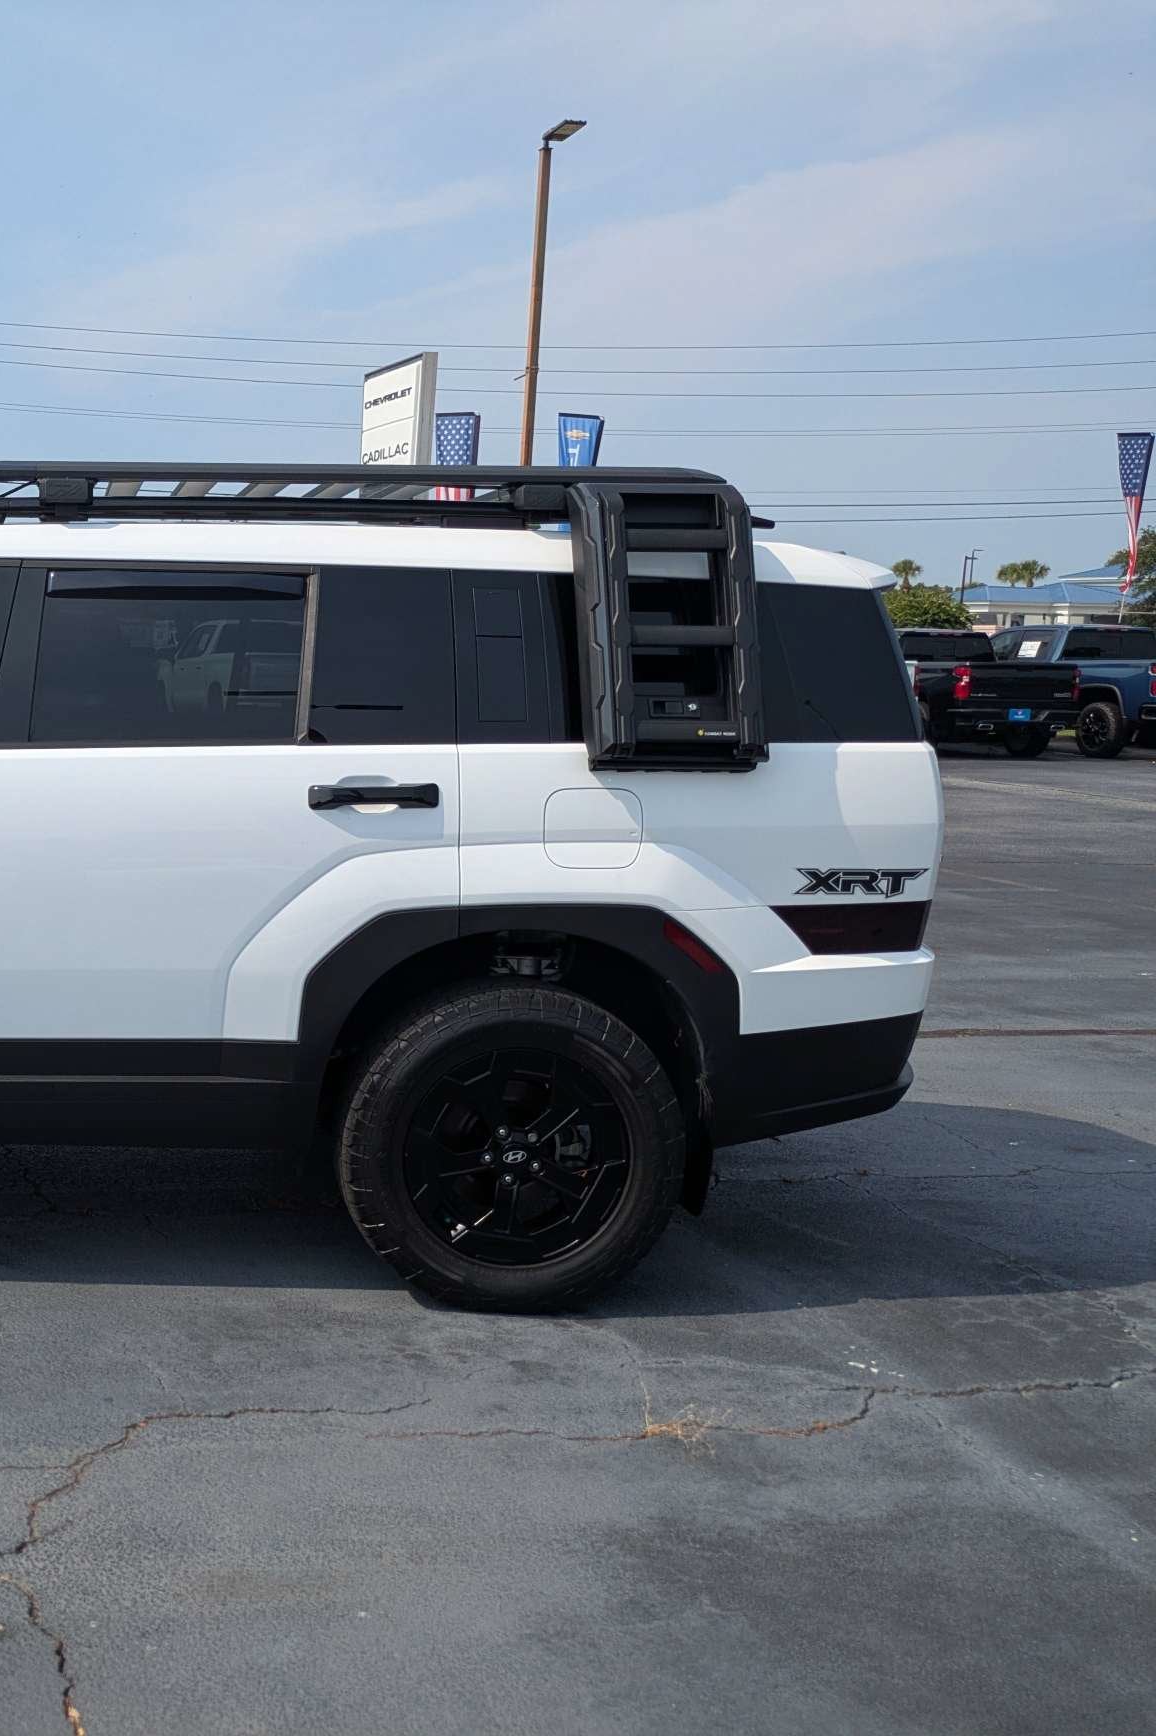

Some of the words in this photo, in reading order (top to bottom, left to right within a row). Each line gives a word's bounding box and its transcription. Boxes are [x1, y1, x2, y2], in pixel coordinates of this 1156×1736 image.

[364, 387, 412, 410] CHEVROLET
[362, 442, 409, 465] CADILLAC
[794, 868, 930, 898] XRT
